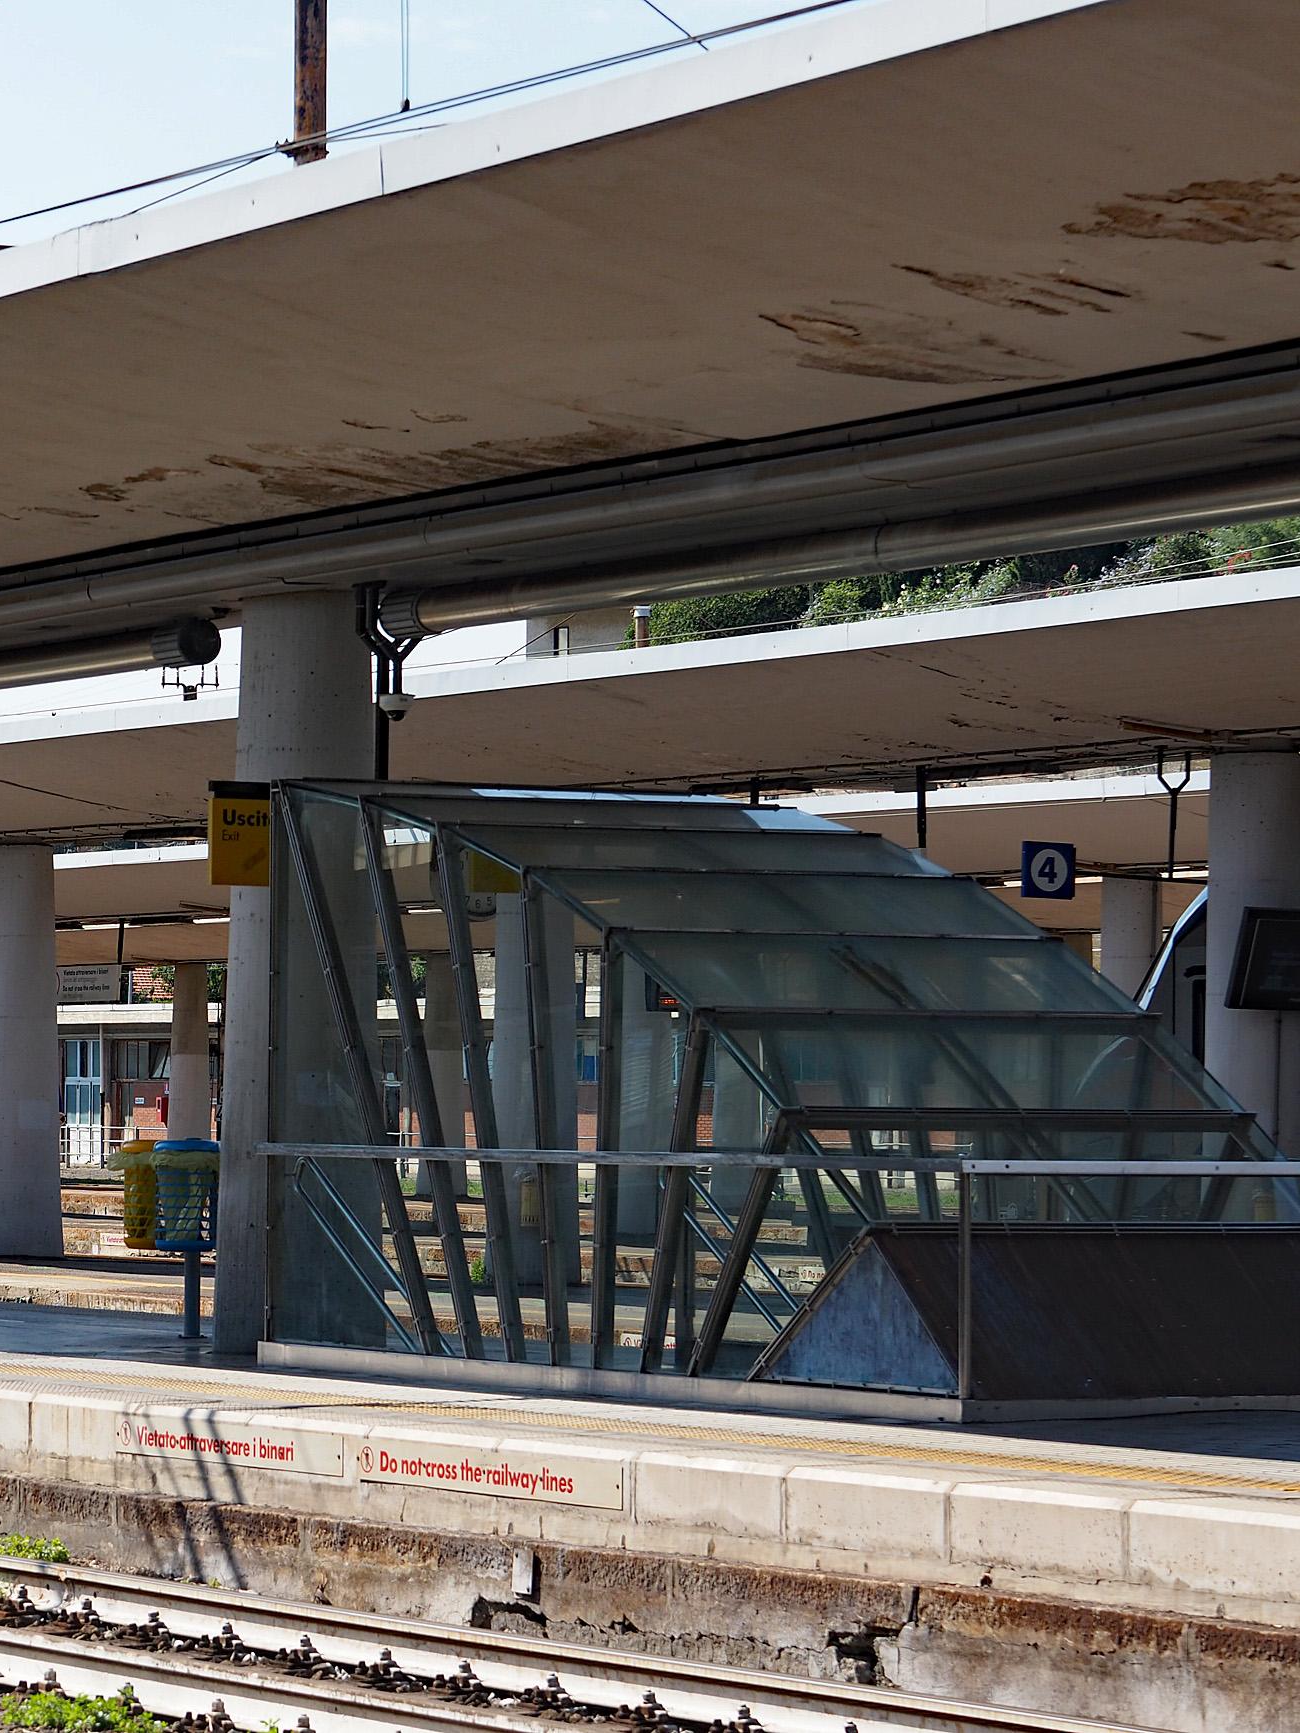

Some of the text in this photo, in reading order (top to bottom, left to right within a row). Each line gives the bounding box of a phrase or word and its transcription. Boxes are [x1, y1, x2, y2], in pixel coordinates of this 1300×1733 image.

[222, 808, 271, 827] Uscit
[221, 829, 240, 842] Exit
[1037, 856, 1058, 885] 4
[136, 1425, 177, 1449] Vietato
[178, 1432, 250, 1457] attraversare
[259, 1436, 295, 1461] binari
[379, 1450, 575, 1496] Do not cross the railway lines
